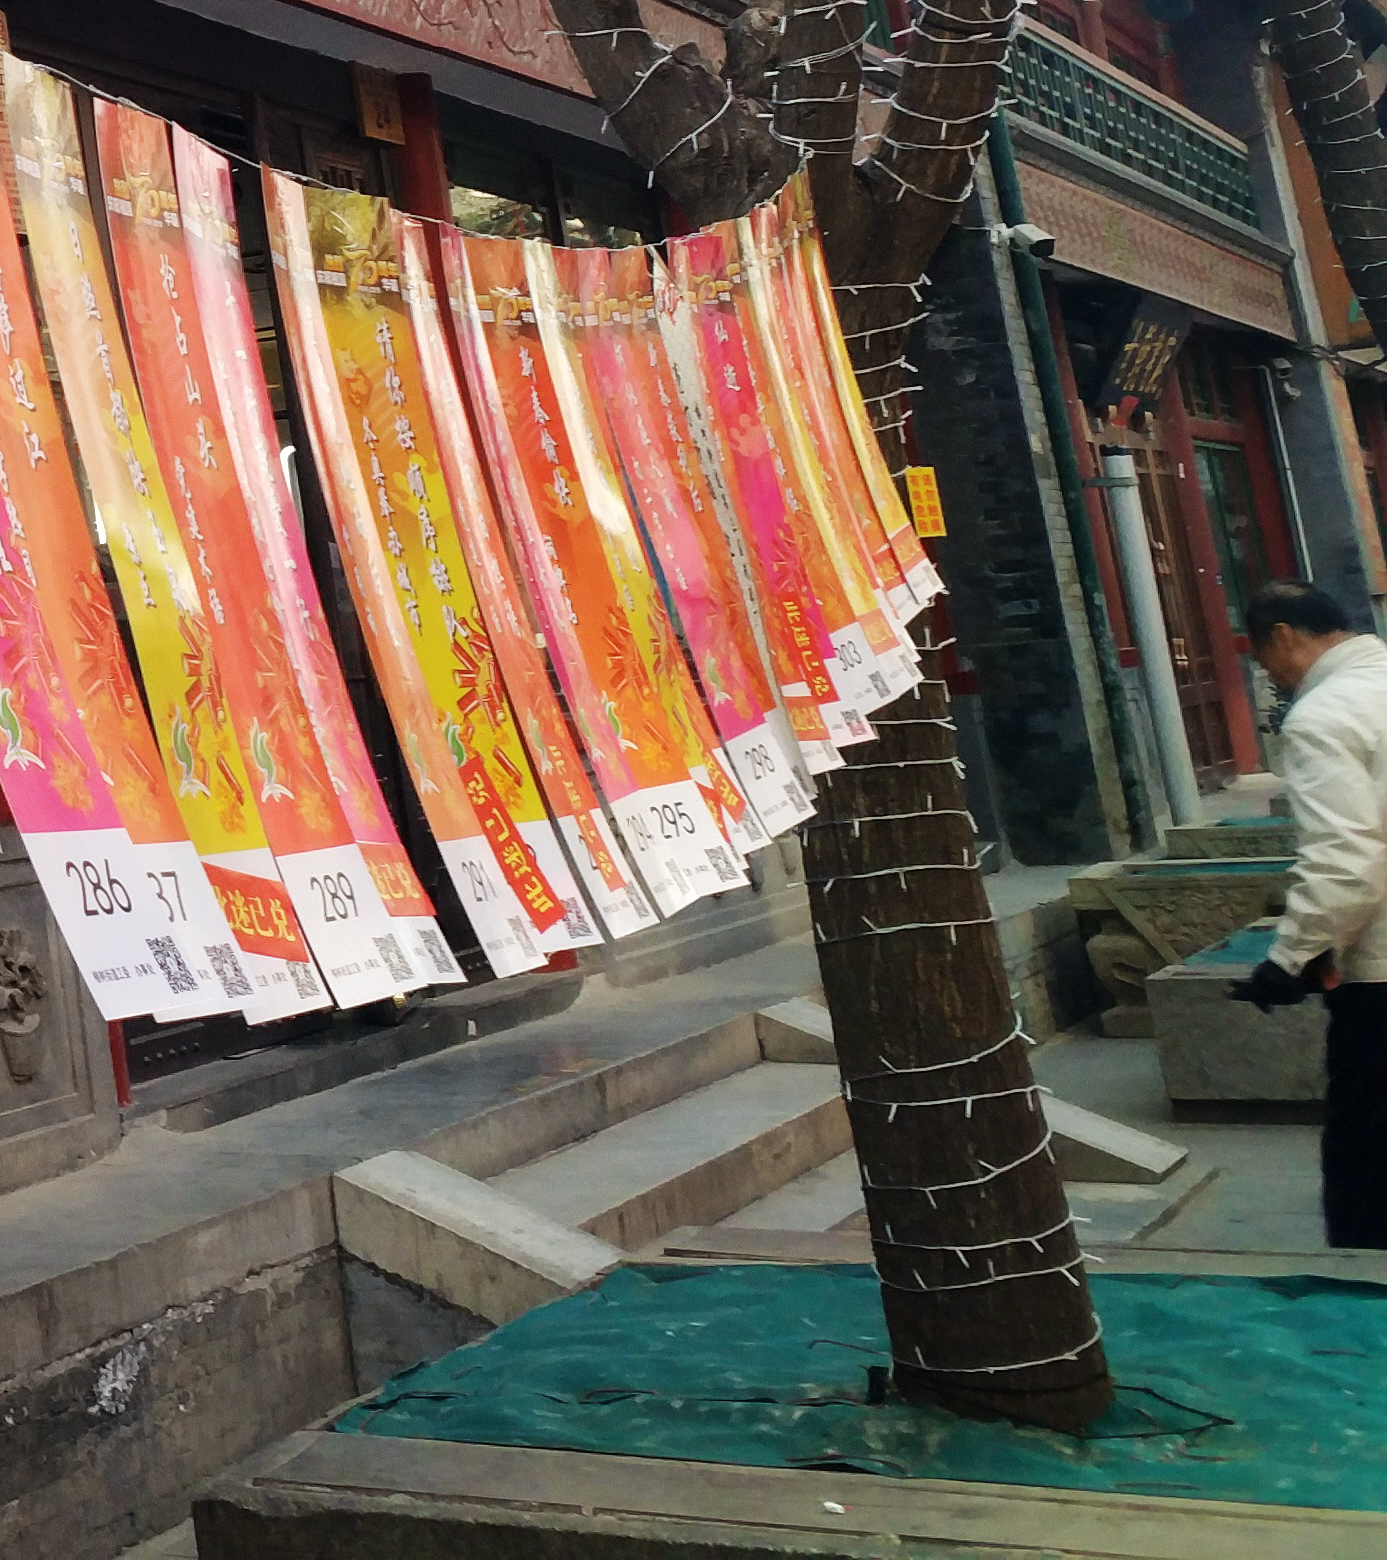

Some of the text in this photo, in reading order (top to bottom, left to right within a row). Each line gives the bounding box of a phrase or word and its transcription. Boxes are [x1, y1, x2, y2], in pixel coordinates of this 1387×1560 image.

[744, 743, 775, 781] 298
[650, 801, 695, 840] 295
[66, 858, 132, 918] 286
[310, 872, 357, 924] 289
